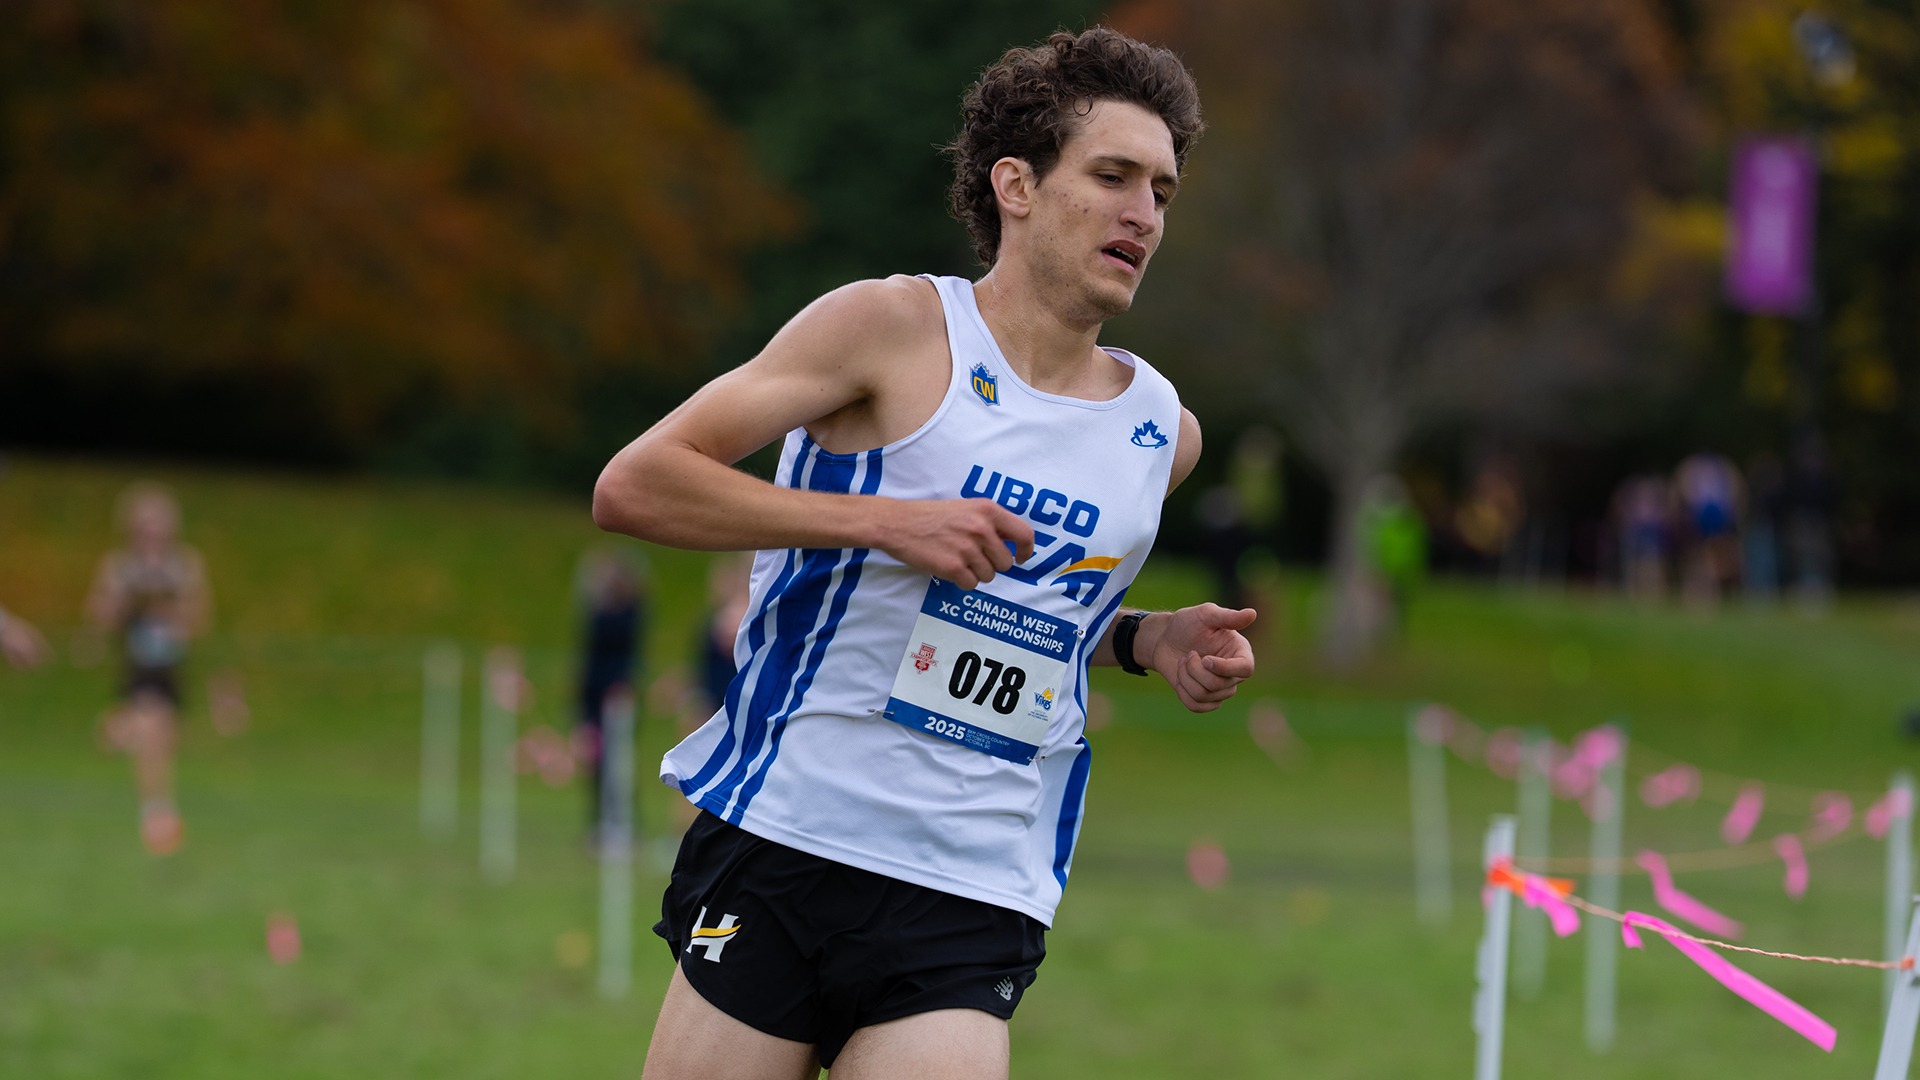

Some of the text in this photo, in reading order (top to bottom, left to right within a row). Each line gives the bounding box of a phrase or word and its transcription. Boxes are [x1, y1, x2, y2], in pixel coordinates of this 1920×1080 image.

[960, 464, 1100, 538] UBCO
[939, 600, 1065, 653] XC CHAMPIONSHIPS
[962, 594, 1058, 637] CANADA WEST
[948, 651, 1026, 715] 078
[924, 716, 966, 740] 2025
